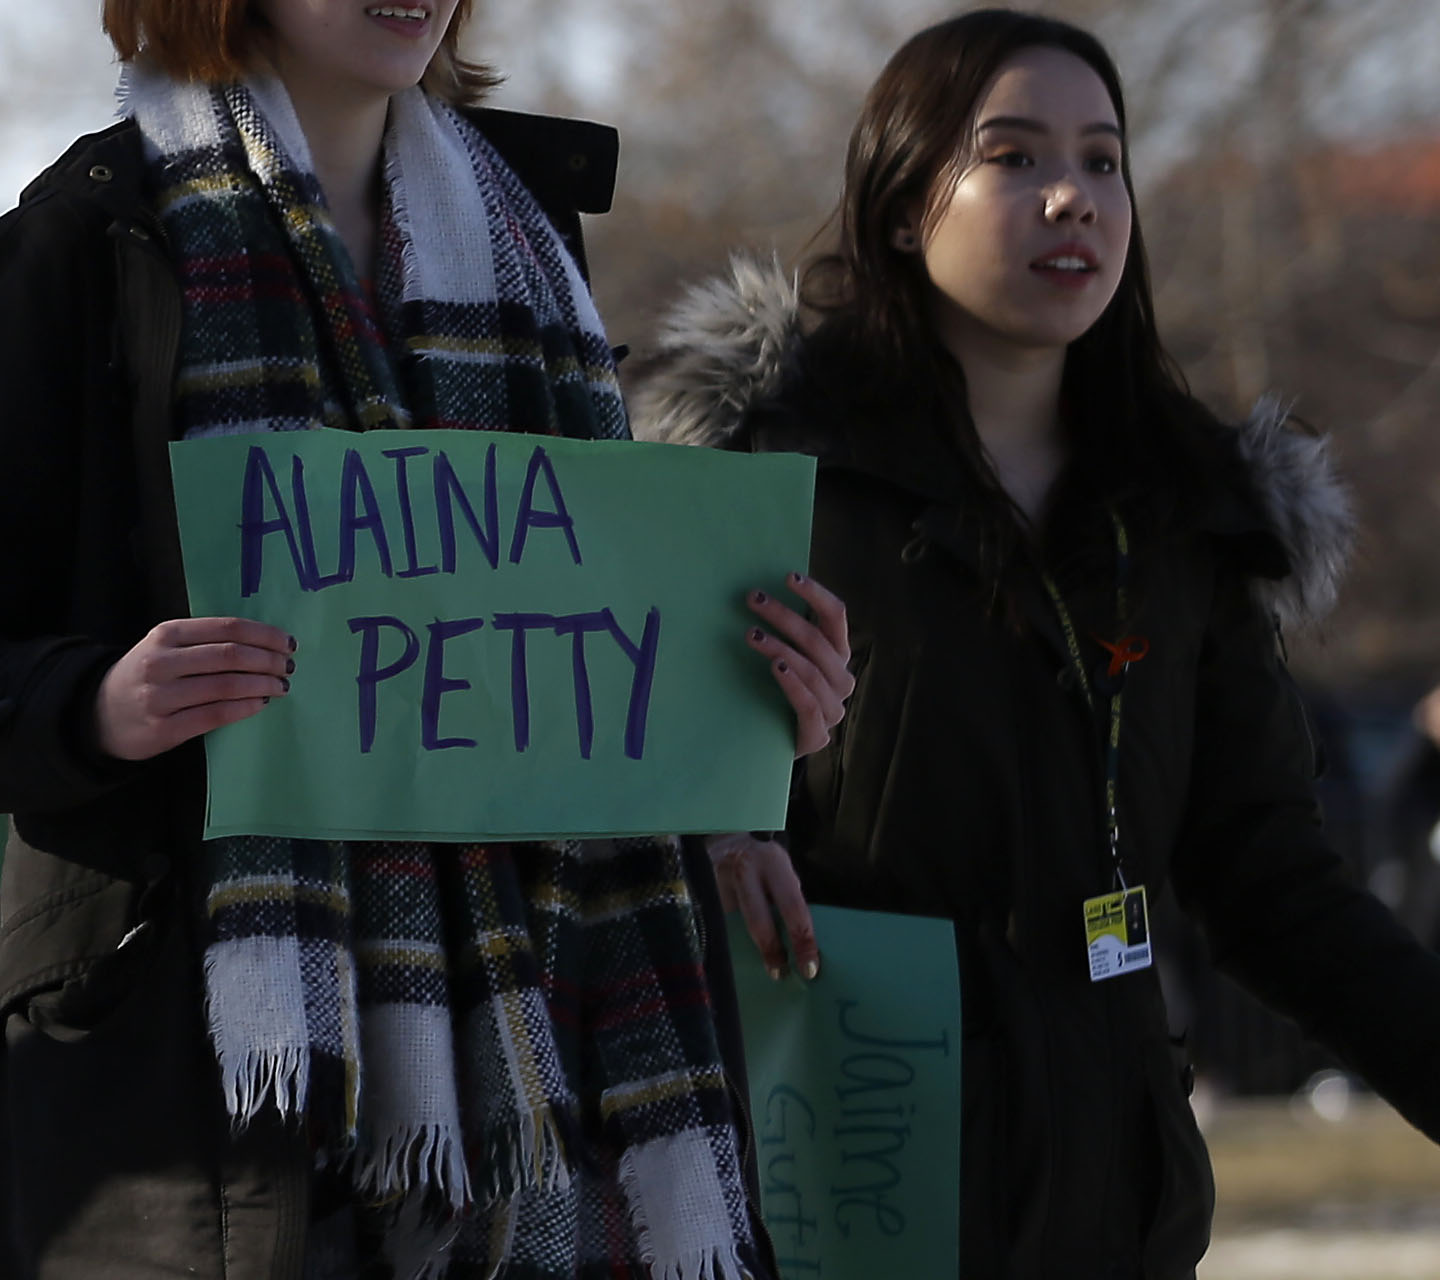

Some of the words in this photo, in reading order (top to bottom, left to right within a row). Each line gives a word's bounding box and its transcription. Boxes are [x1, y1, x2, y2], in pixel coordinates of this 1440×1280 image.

[236, 443, 583, 598] ALAINA
[348, 605, 662, 761] PETTY
[833, 999, 950, 1238] Jaime
